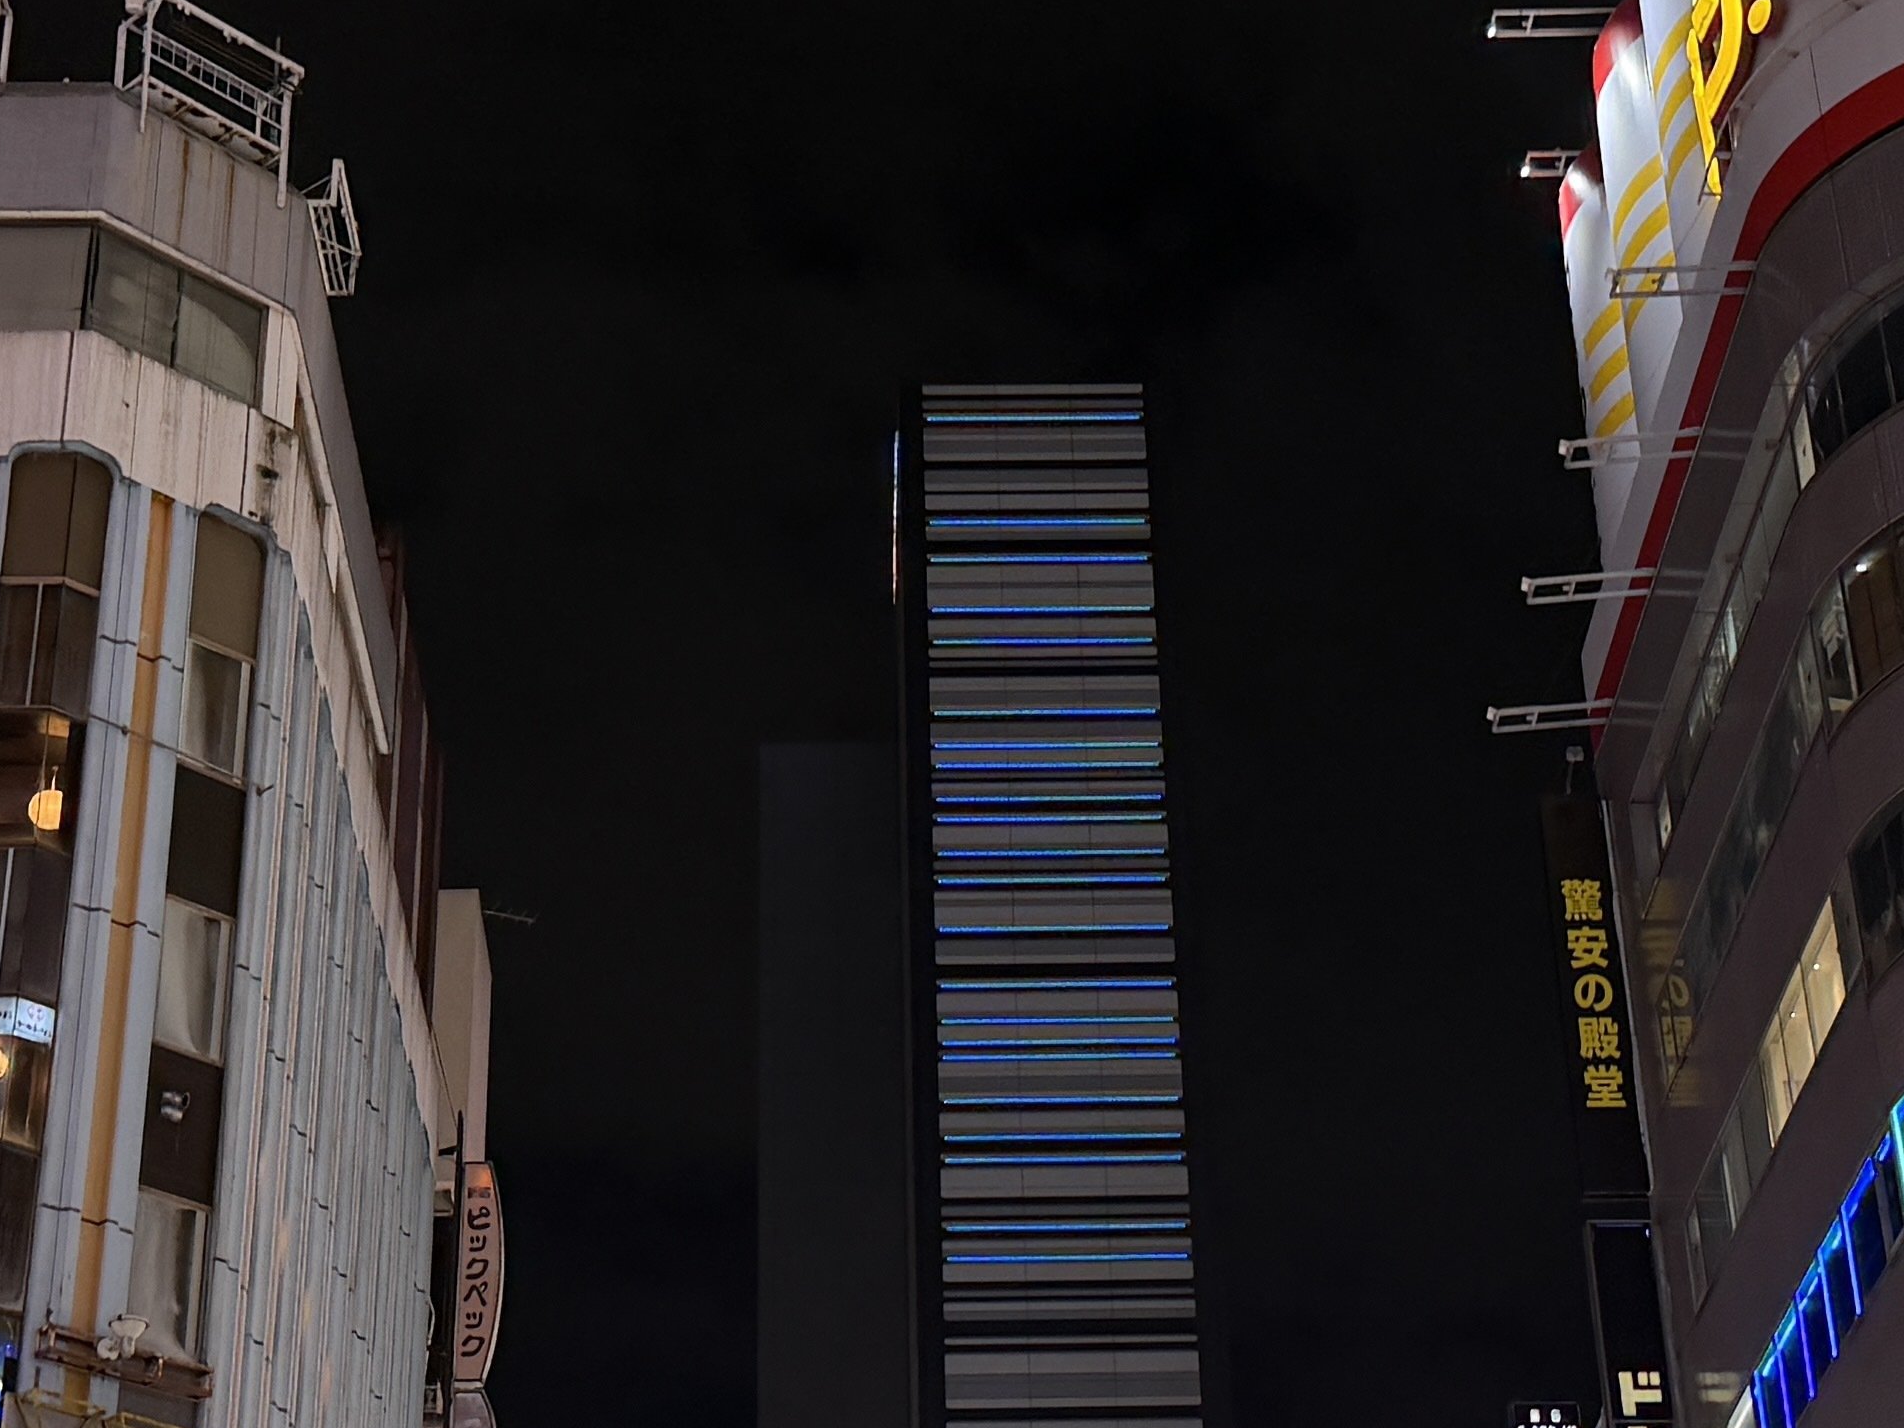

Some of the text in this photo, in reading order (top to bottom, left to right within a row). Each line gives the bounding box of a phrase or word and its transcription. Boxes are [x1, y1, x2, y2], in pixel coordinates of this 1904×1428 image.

[1561, 879, 1627, 1108] 驚安の殿堂
